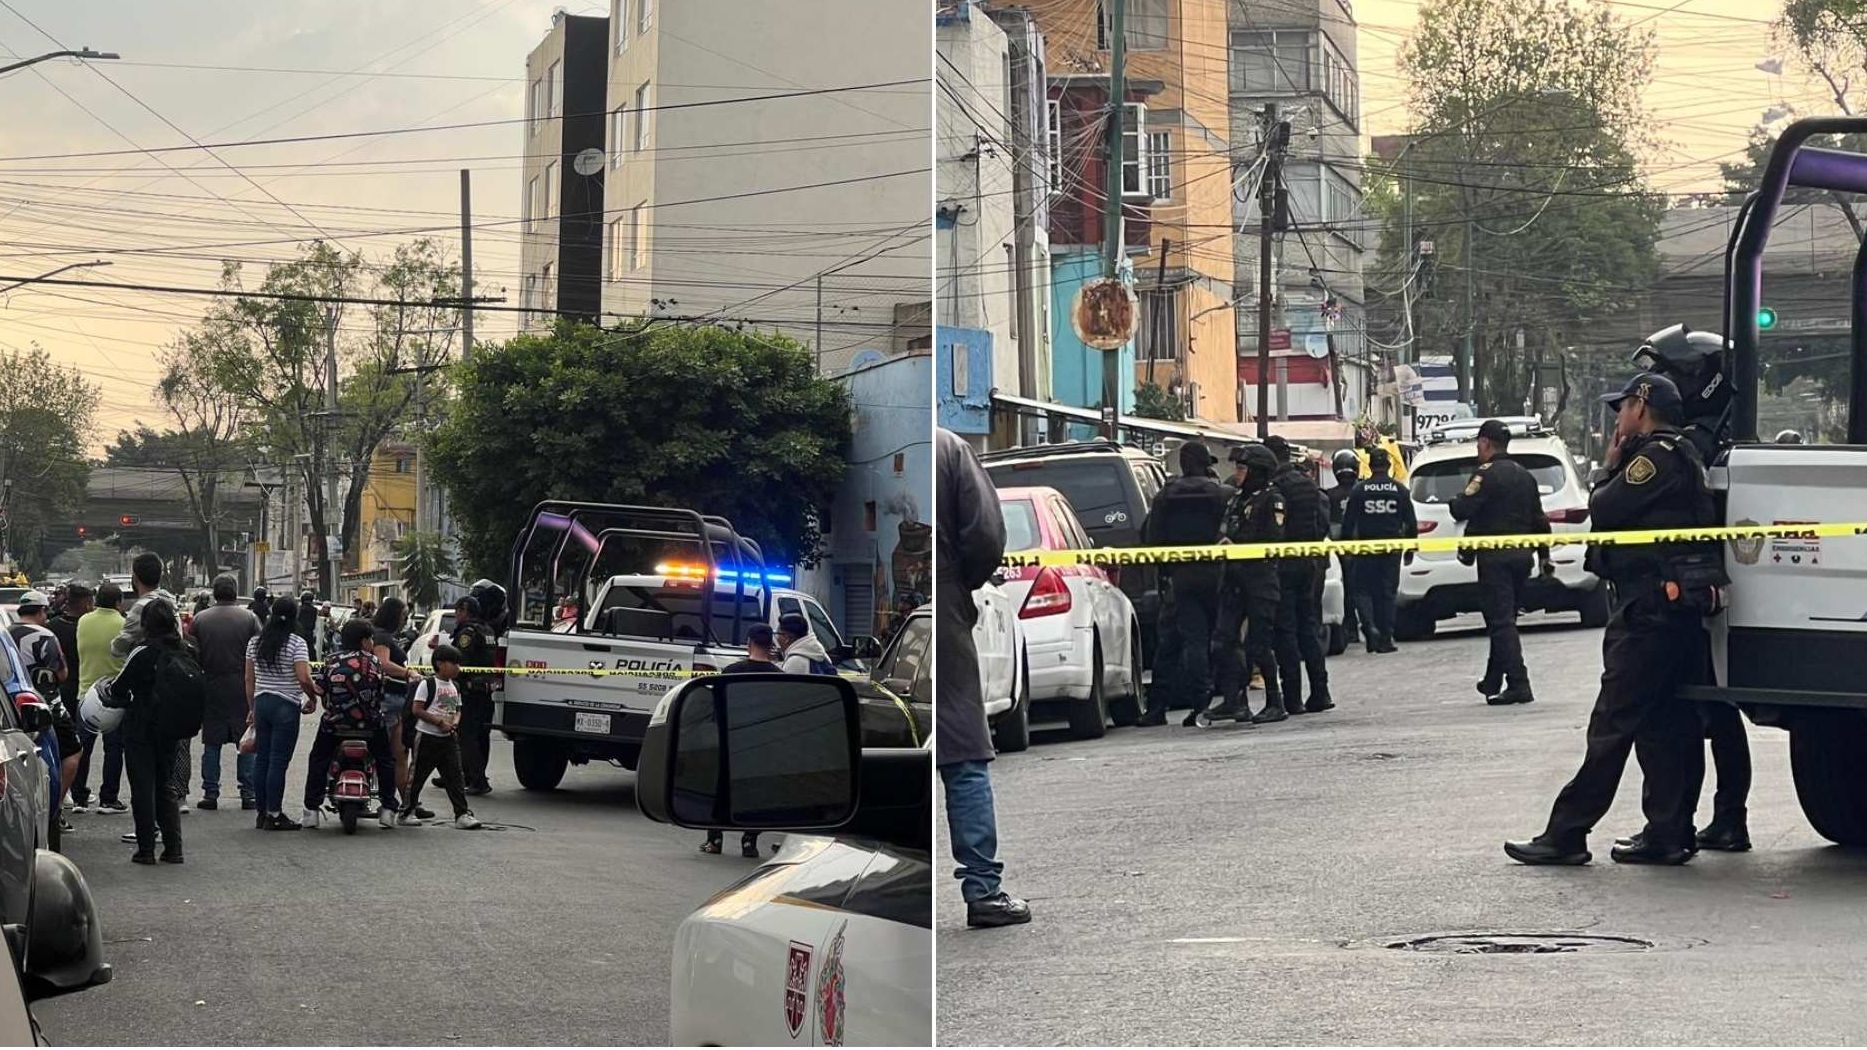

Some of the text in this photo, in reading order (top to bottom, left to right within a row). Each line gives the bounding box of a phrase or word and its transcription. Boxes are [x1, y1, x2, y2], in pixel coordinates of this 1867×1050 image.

[1364, 482, 1398, 492] POLICÍA
[1364, 499, 1398, 514] SSC
[615, 658, 683, 672] POLICÍA
